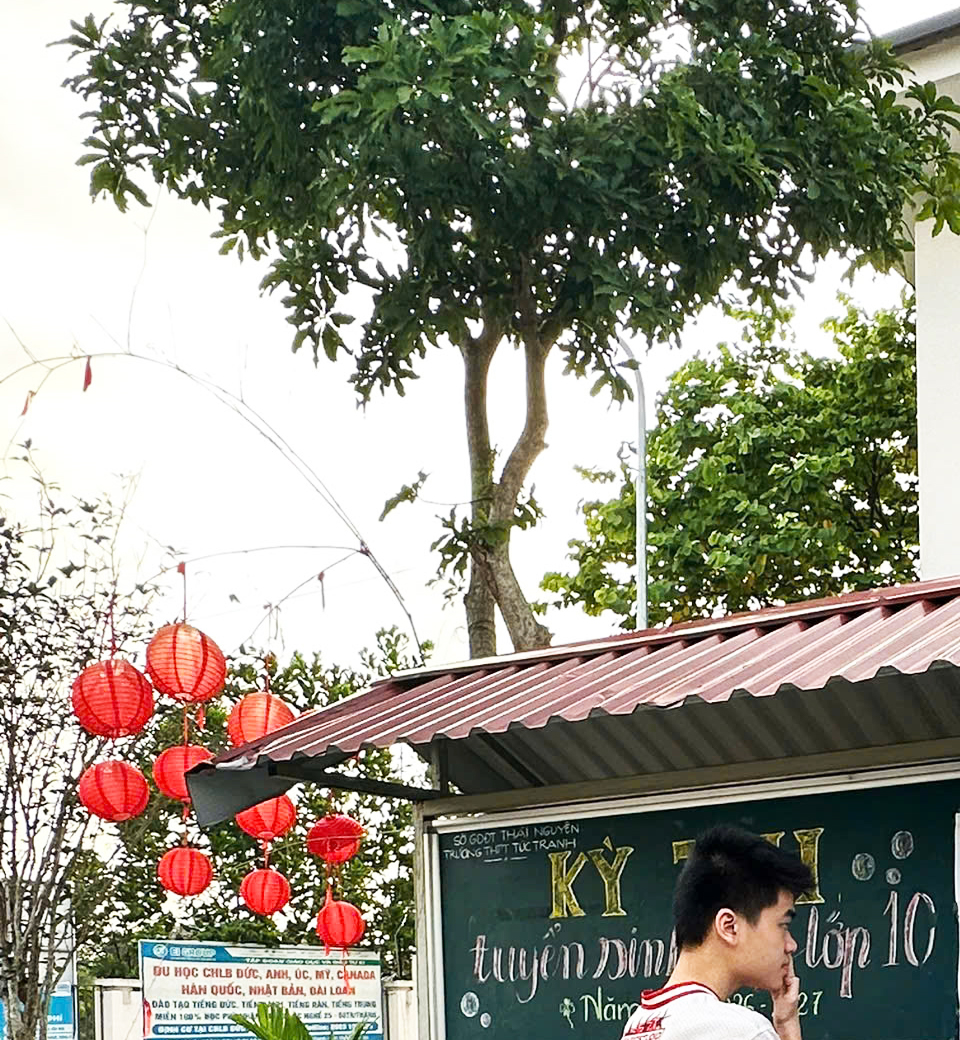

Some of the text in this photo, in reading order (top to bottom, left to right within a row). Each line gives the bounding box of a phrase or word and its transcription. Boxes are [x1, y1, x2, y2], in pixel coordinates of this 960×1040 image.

[531, 838, 577, 850] TRANH
[548, 836, 634, 919] KỲ
[470, 922, 587, 1003] tuyển
[805, 903, 871, 999] lớp
[881, 890, 937, 967] 10
[174, 966, 199, 980] HỌC
[203, 967, 233, 978] CHLB
[265, 969, 292, 981] ANH,
[181, 982, 207, 995] HÀN
[211, 981, 246, 996] QUỐC,
[249, 983, 278, 997] NHẬT
[281, 982, 307, 997] BẢN,
